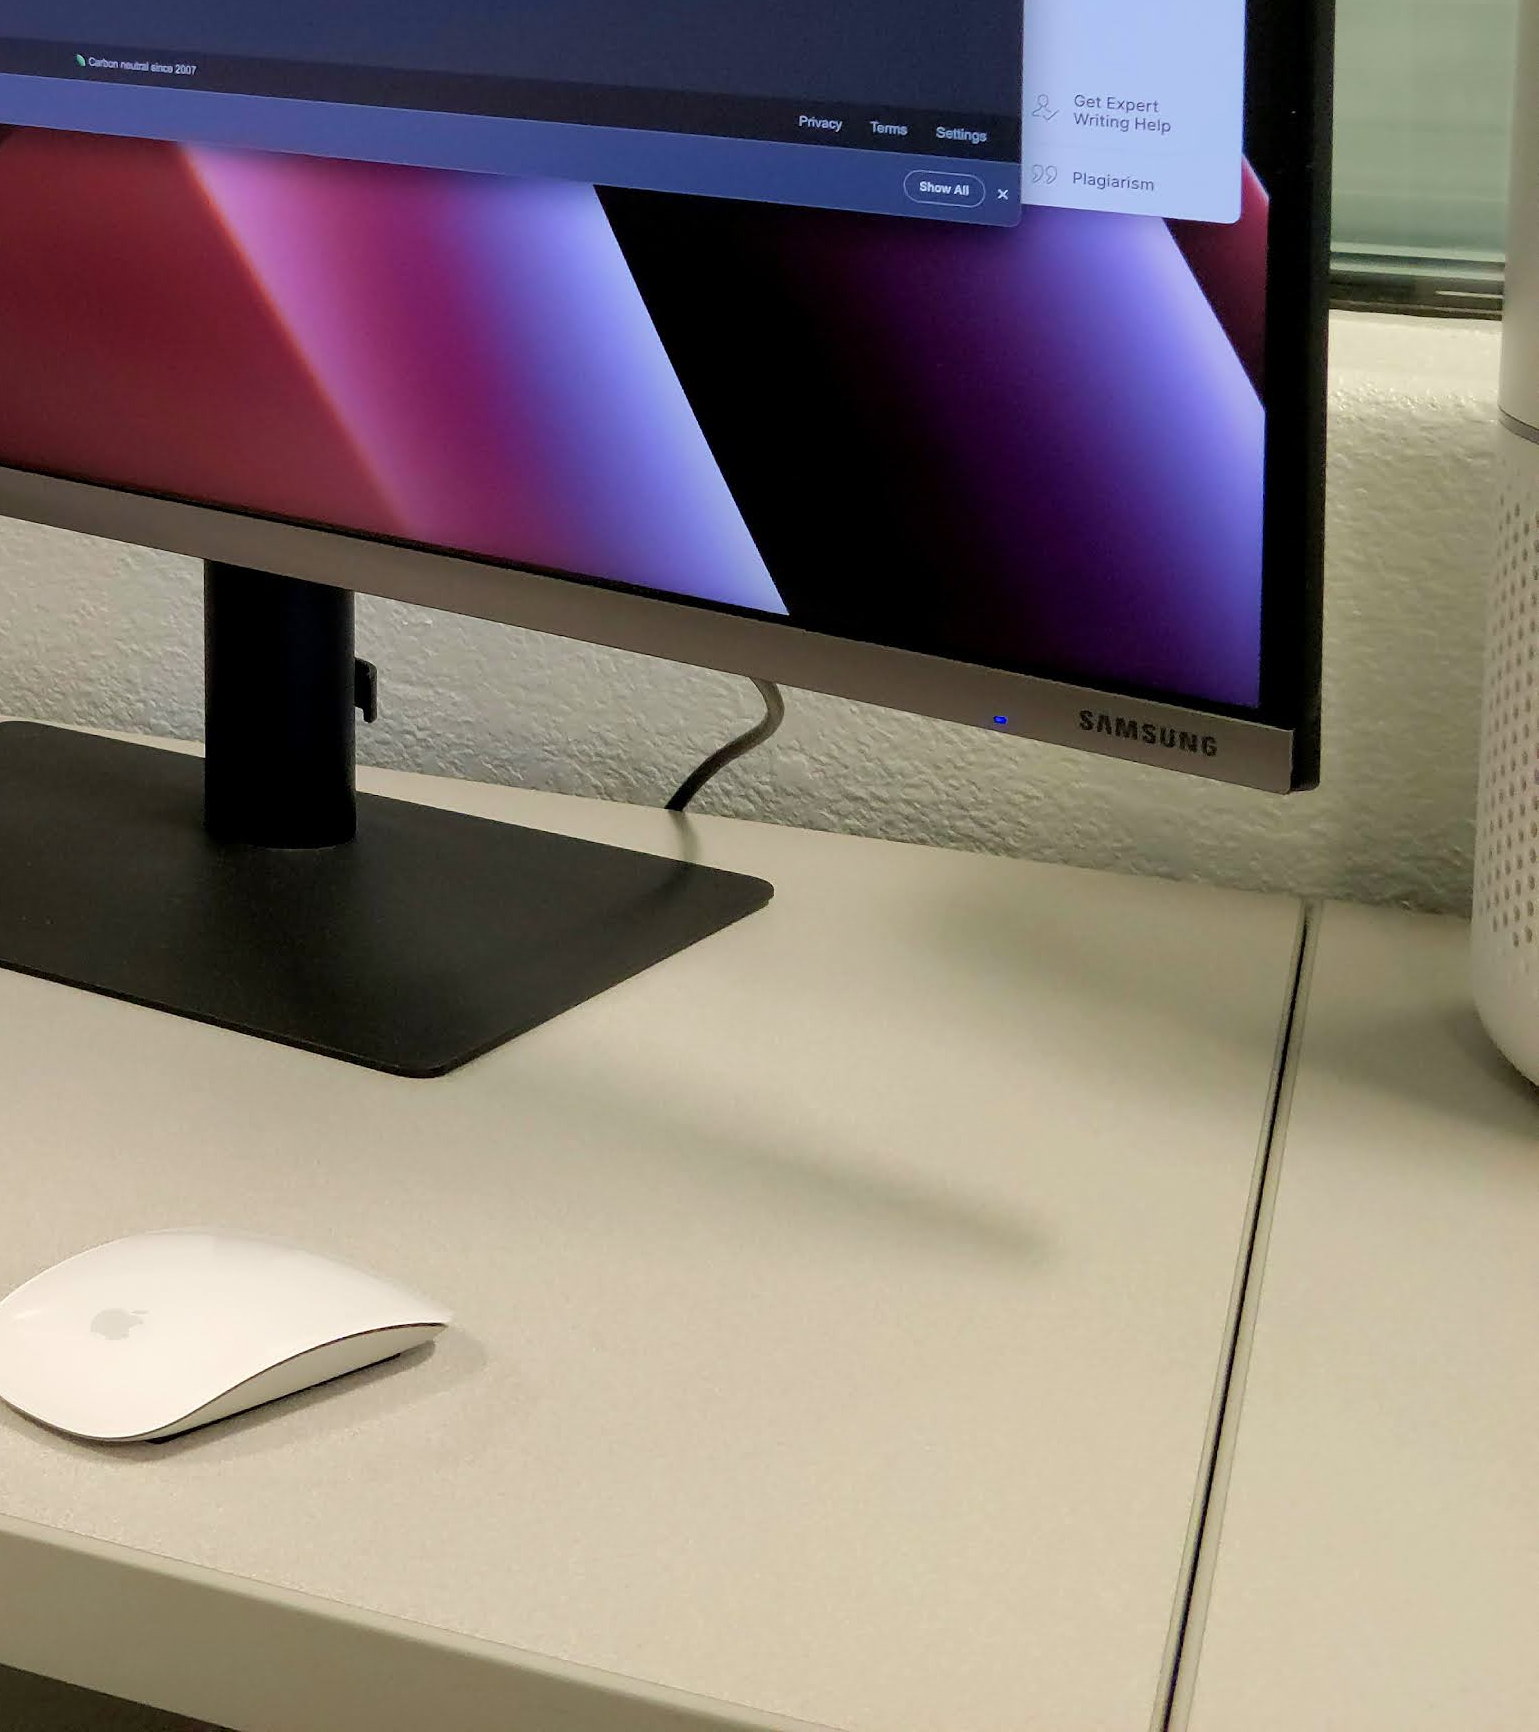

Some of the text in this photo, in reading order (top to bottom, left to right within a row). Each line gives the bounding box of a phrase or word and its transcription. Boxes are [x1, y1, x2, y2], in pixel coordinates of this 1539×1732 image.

[88, 56, 197, 76] Carbon neutral since 2007
[1074, 94, 1159, 113] Get Expert
[799, 115, 843, 133] Privacy
[870, 121, 908, 136] Terms
[1073, 113, 1172, 134] Writing Help
[936, 126, 987, 144] Settings
[919, 181, 969, 196] Show All
[1072, 171, 1155, 192] Plagiarism
[1078, 709, 1218, 758] SAMSUNG
